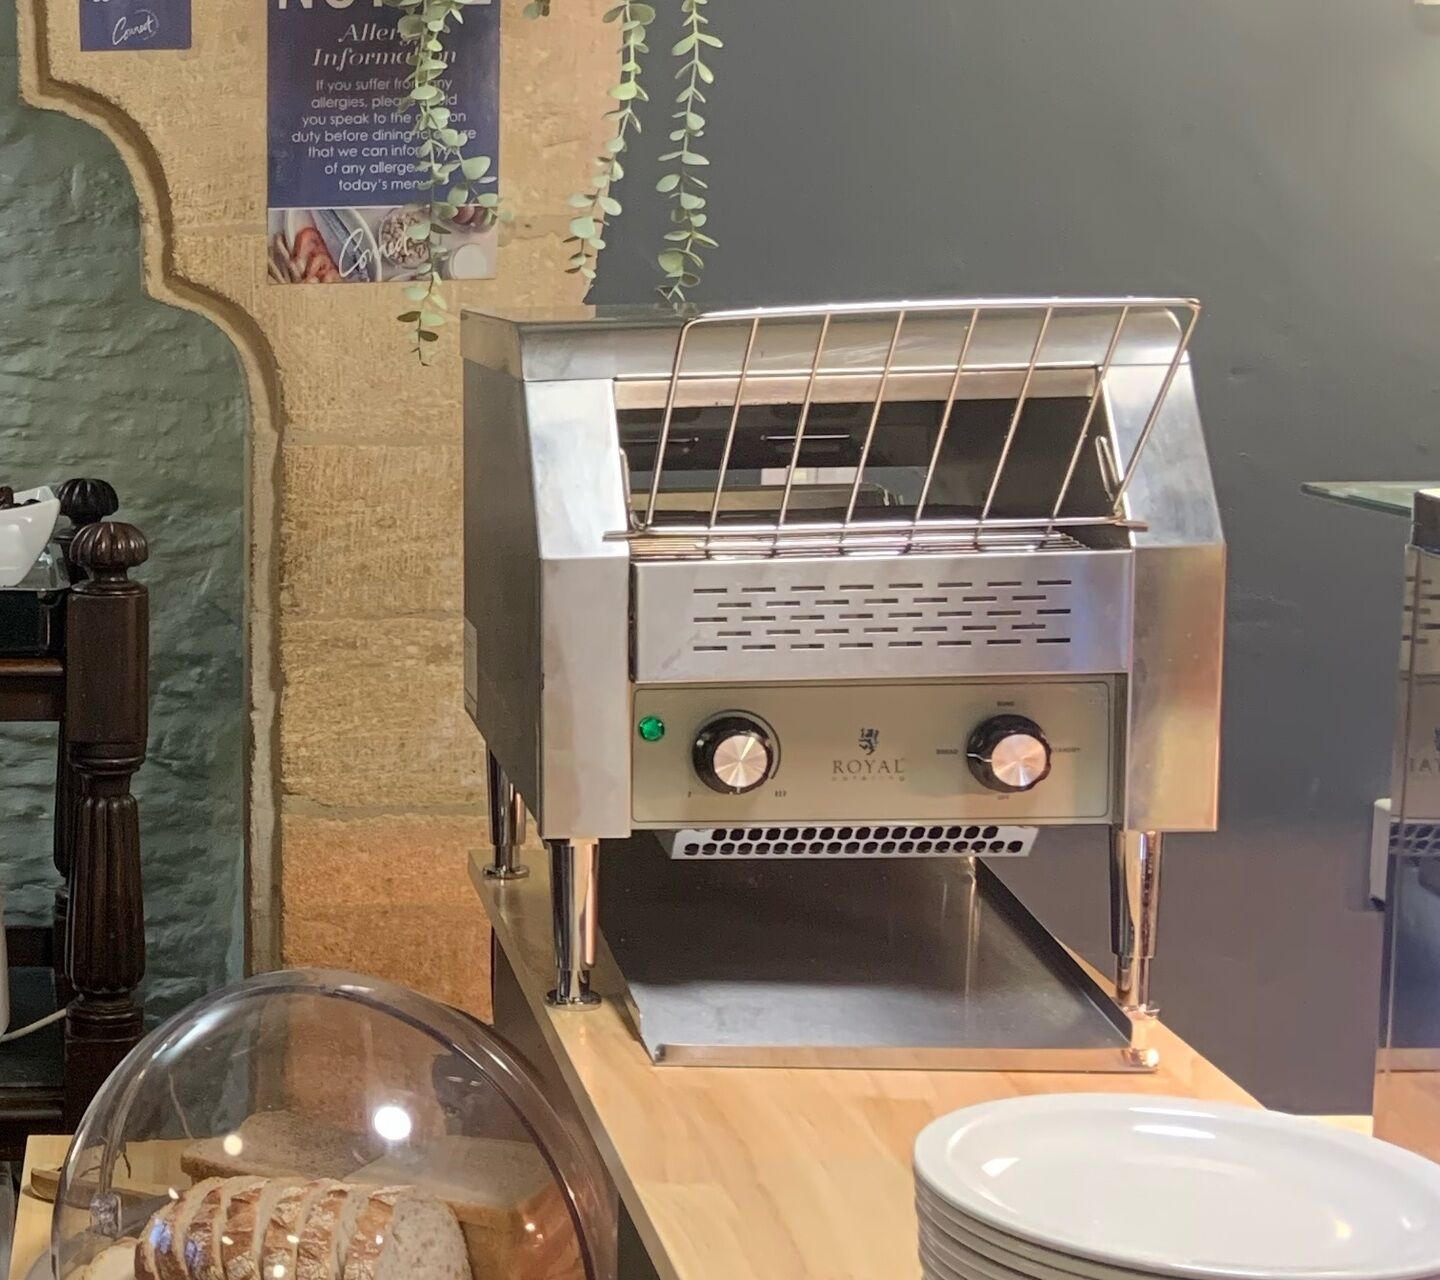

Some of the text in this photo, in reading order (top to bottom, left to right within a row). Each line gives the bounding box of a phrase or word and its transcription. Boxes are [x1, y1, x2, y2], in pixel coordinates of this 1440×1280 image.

[316, 80, 324, 91] If
[327, 81, 352, 95] you
[355, 79, 390, 90] suffer
[302, 116, 327, 127] you
[330, 113, 370, 126] speak
[373, 113, 387, 124] to
[390, 112, 412, 123] the
[291, 131, 321, 145] duty
[324, 130, 368, 142] before
[372, 128, 412, 143] dining
[308, 145, 335, 158] that
[338, 147, 358, 157] we
[361, 147, 389, 157] can
[324, 162, 337, 175] of
[341, 164, 366, 178] any
[338, 179, 388, 194] today's
[832, 759, 904, 774] ROYAL
